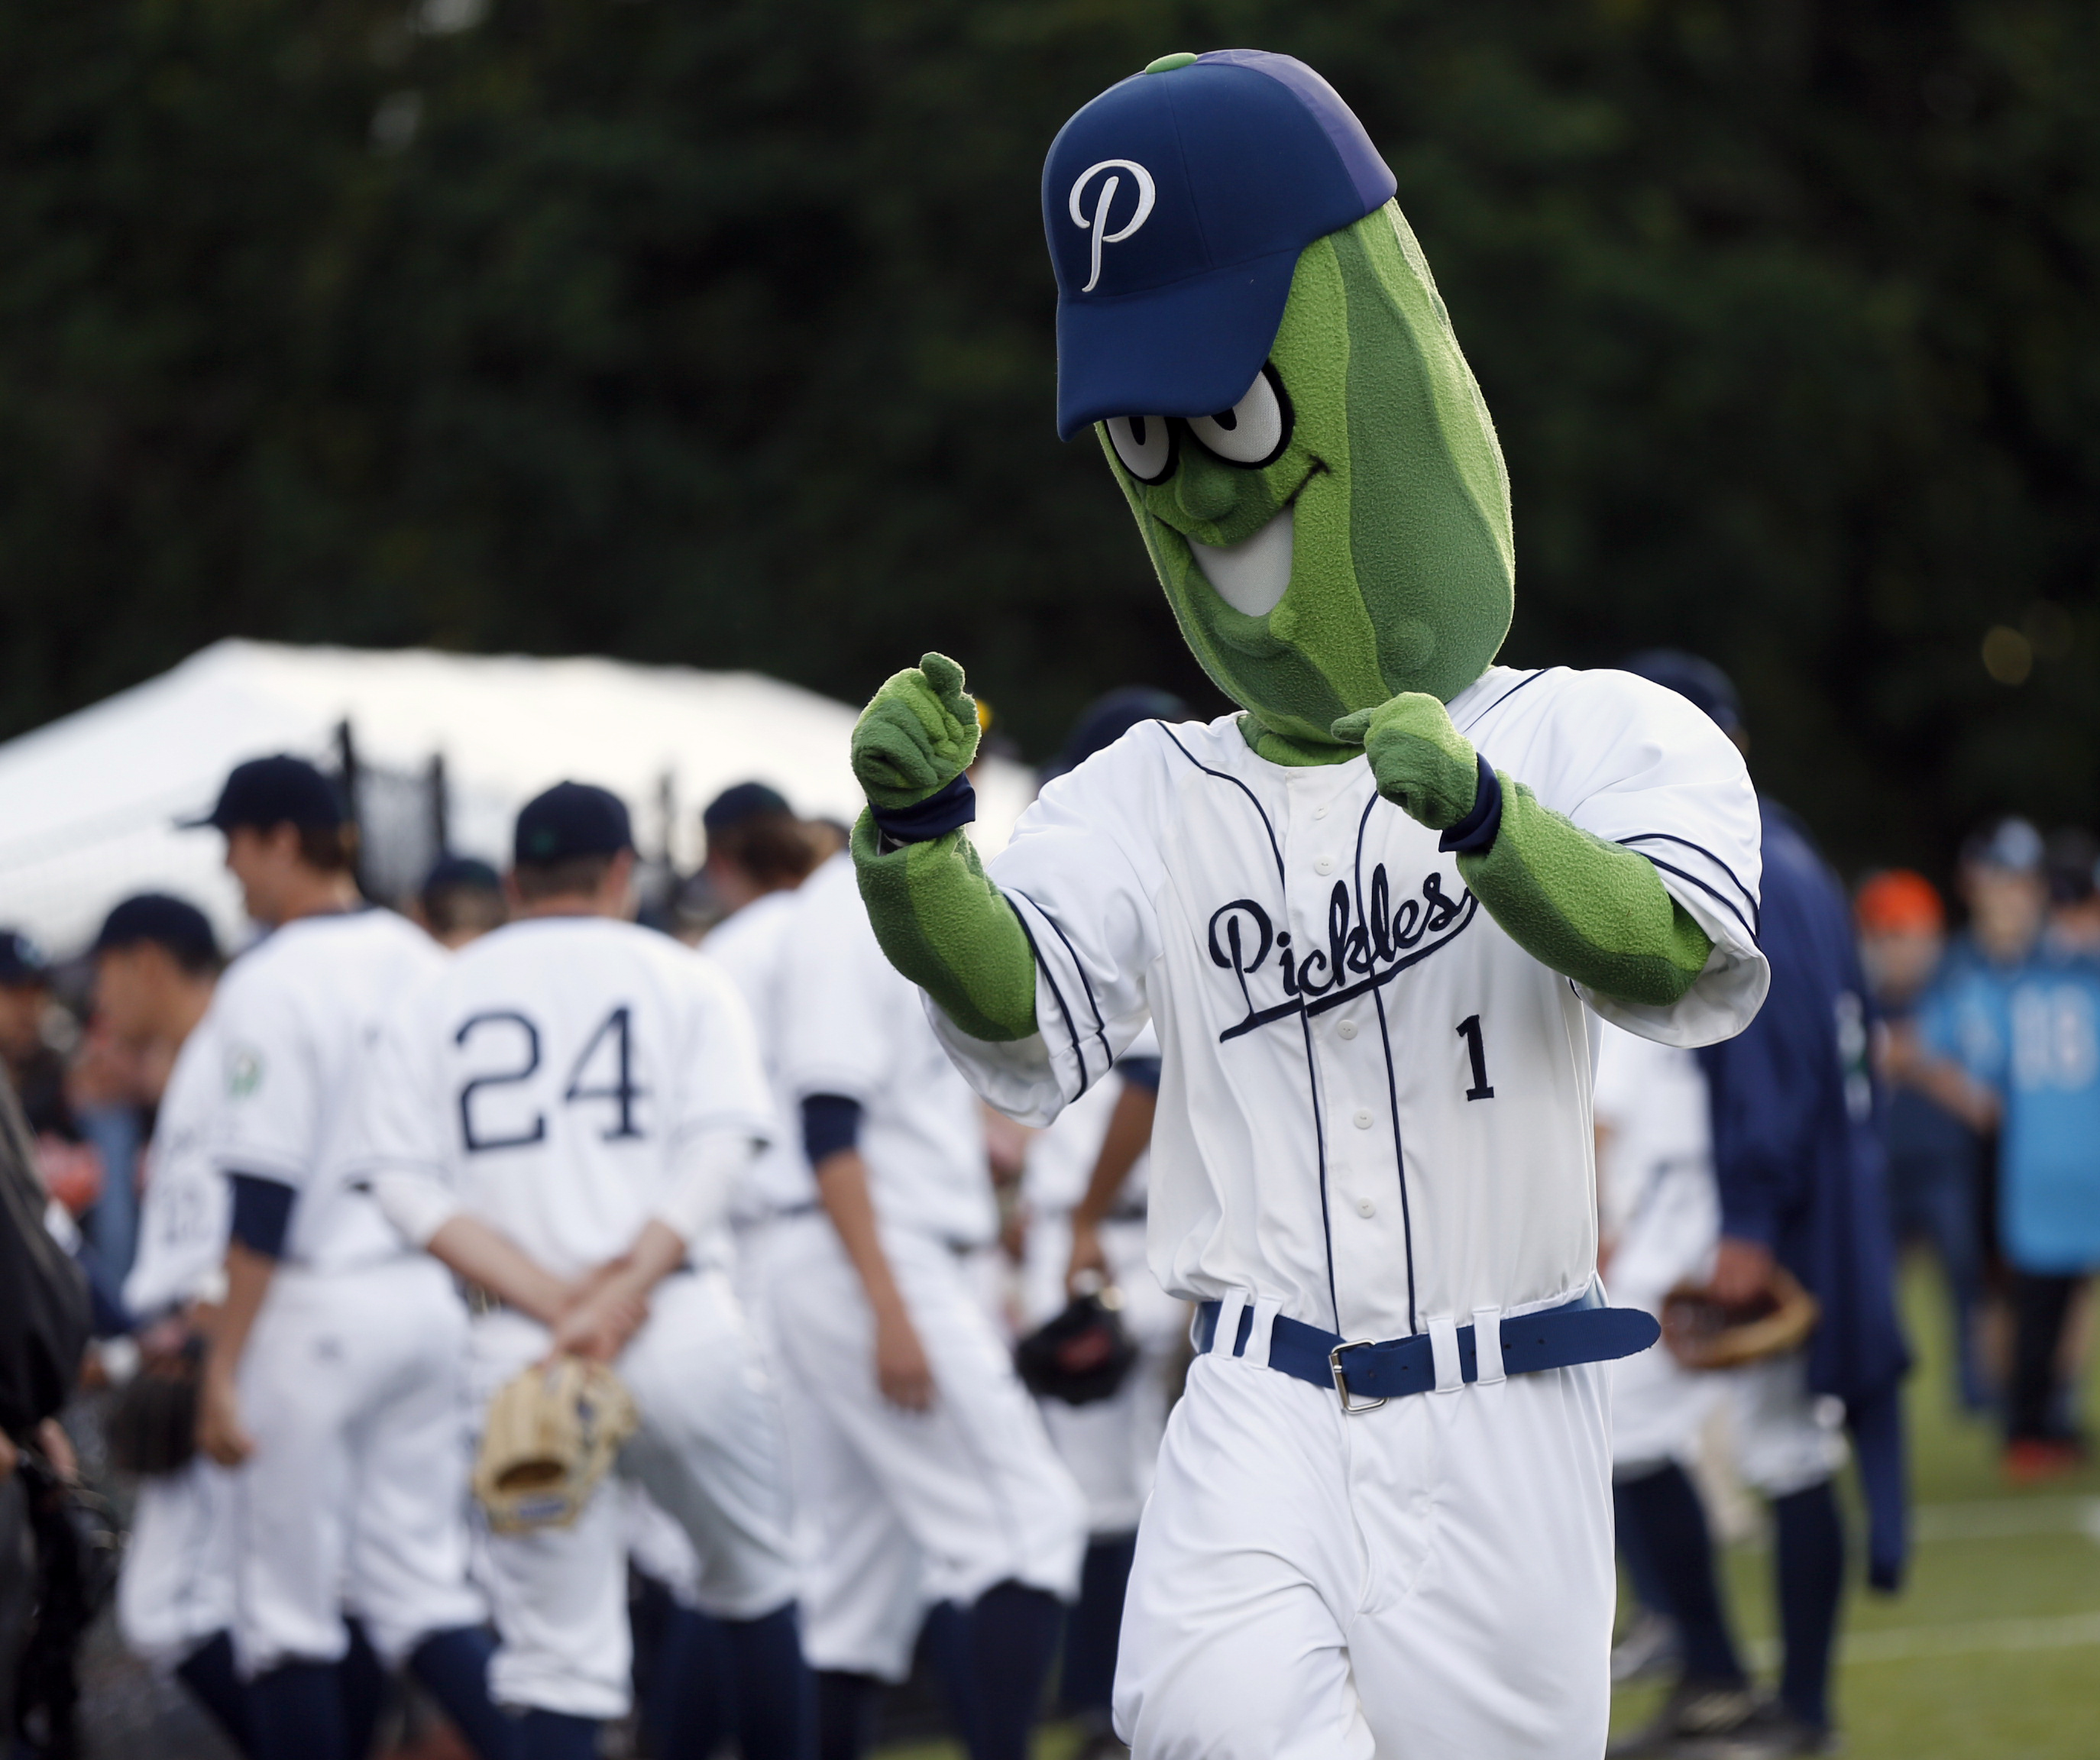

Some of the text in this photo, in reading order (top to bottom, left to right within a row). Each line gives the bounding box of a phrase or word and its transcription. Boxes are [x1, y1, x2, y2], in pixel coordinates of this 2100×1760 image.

[1069, 159, 1156, 293] P
[1209, 863, 1480, 1040] Pickles
[455, 1007, 649, 1152] 24
[1456, 1014, 1494, 1101] 1
